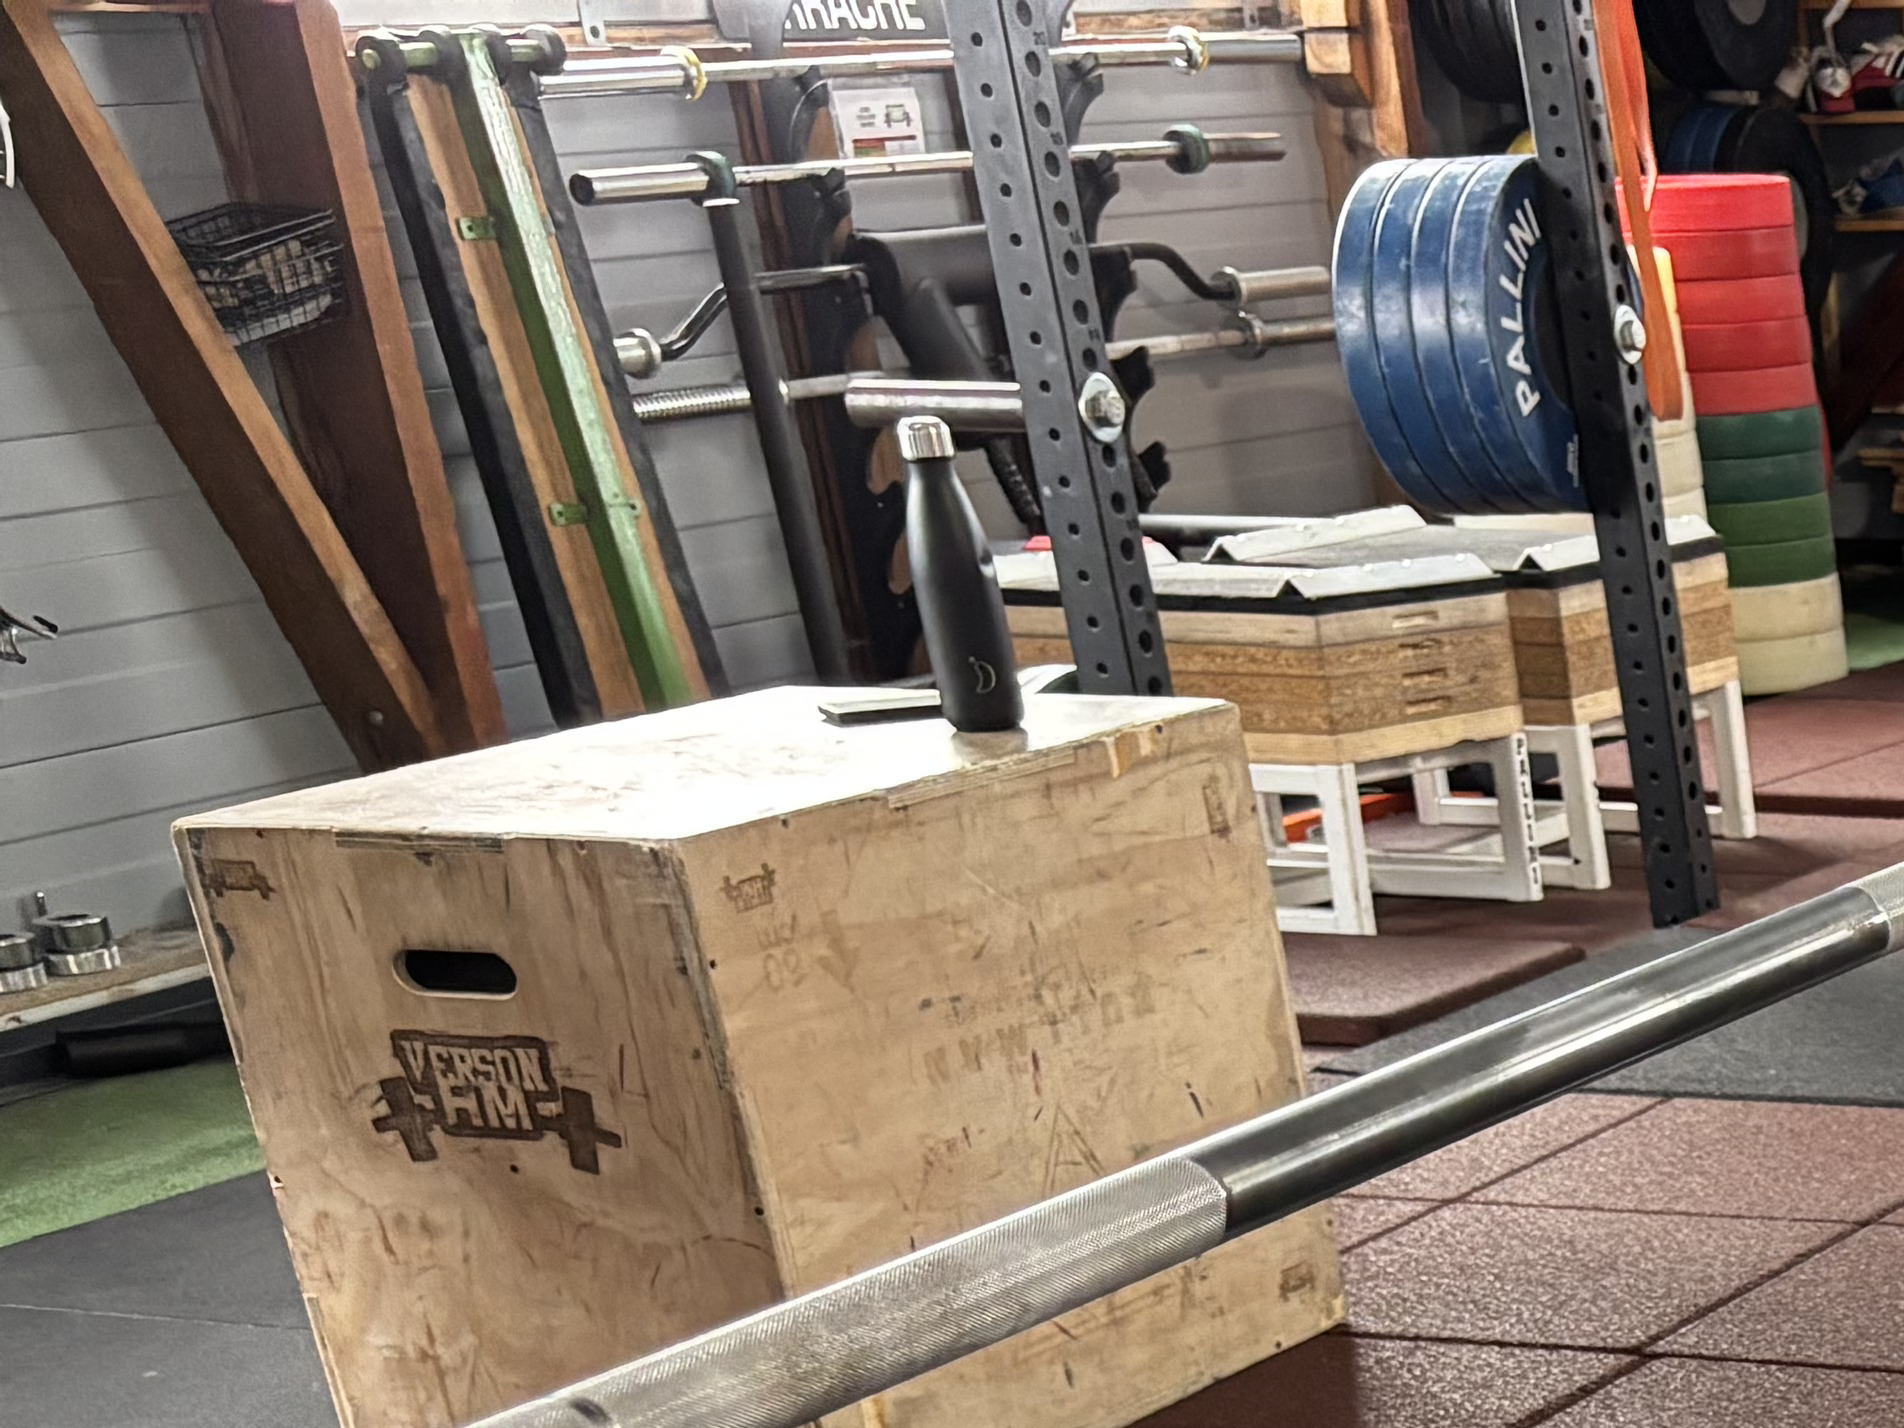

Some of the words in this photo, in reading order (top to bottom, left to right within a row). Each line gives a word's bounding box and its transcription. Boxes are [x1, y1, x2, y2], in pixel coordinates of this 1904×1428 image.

[1499, 198, 1542, 417] PALLINI
[400, 1040, 551, 1093] VERSON
[433, 1084, 535, 1131] HM
